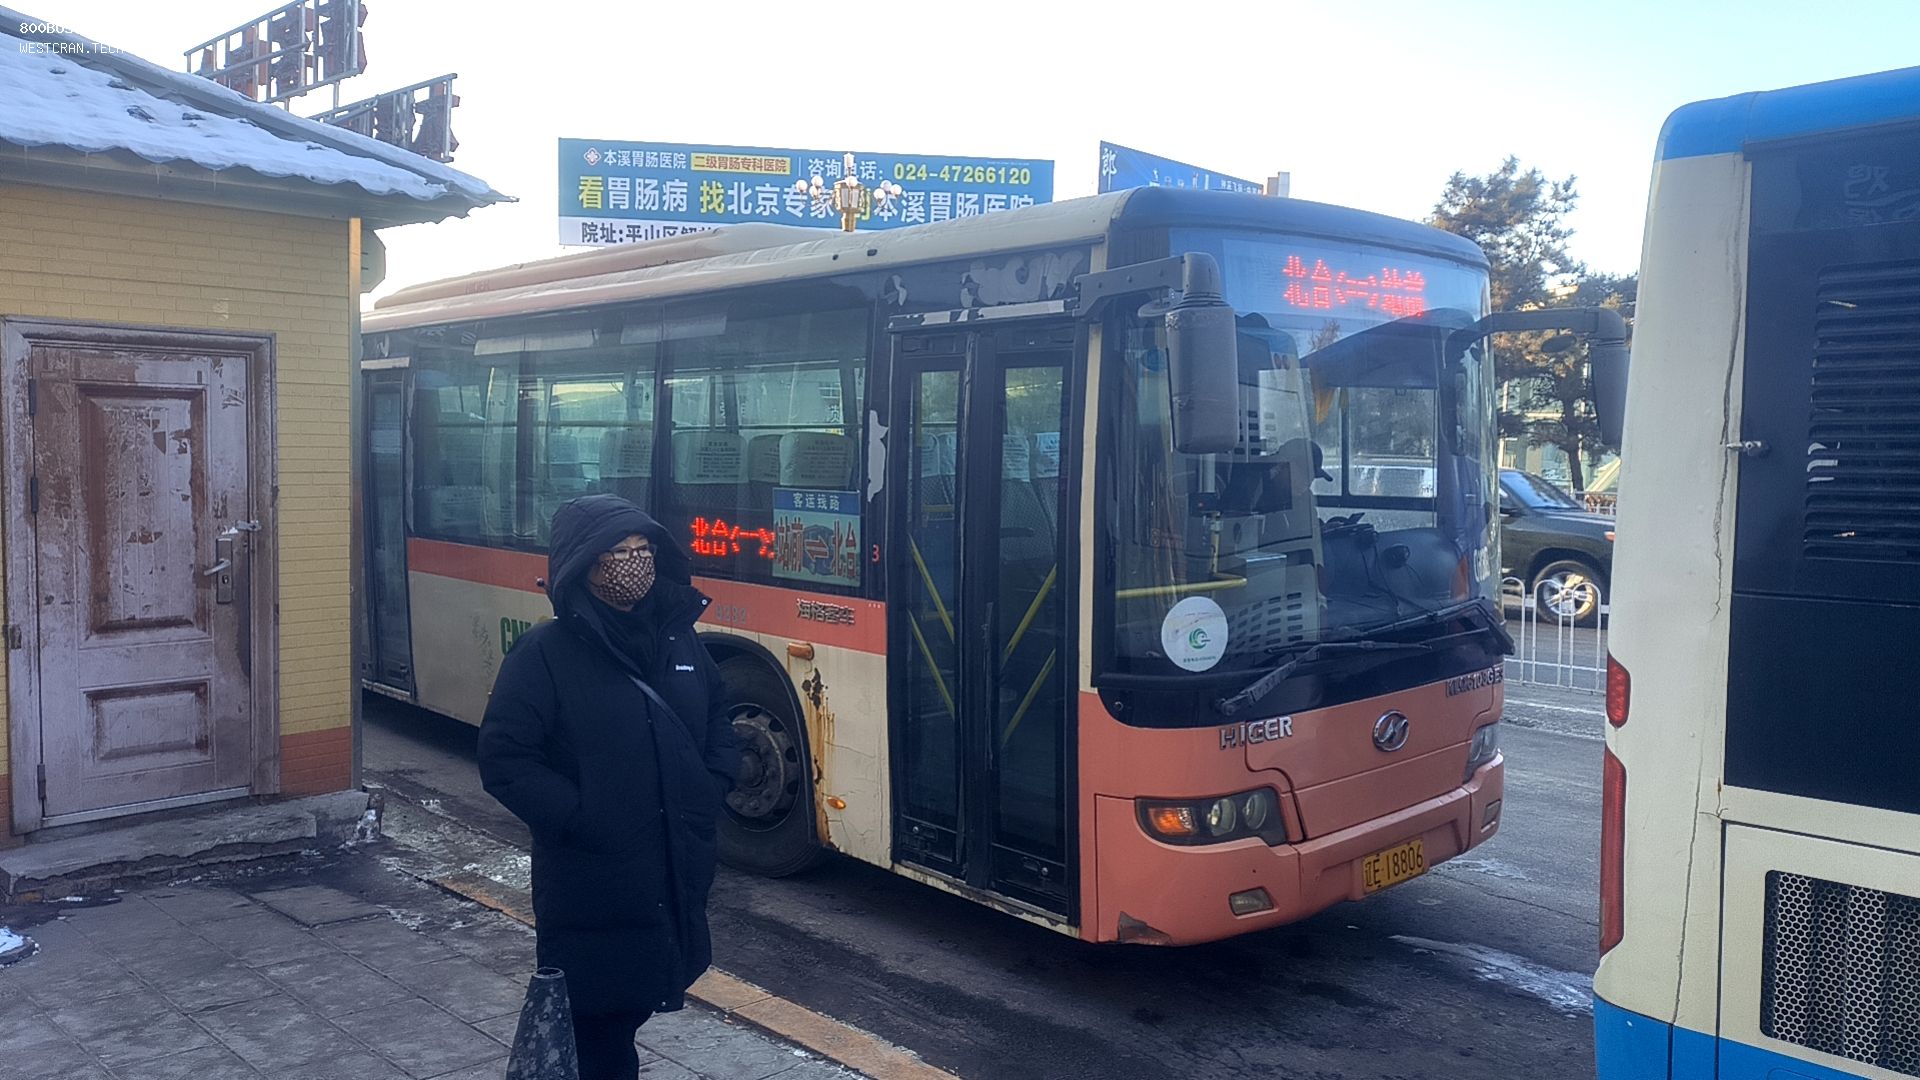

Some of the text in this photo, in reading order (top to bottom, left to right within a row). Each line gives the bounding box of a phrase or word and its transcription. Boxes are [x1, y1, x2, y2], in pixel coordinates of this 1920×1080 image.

[603, 149, 687, 169] 本溪胃肠医院
[694, 155, 787, 172] 二级胃肠专科医院
[894, 163, 1031, 185] 024-47266120
[578, 175, 1034, 224] 看胃肠病 找北京专家本溪胃肠医
[792, 492, 841, 511] 客运线路
[871, 544, 881, 563] 3
[500, 616, 532, 656] CN
[1219, 716, 1293, 750] HIGER
